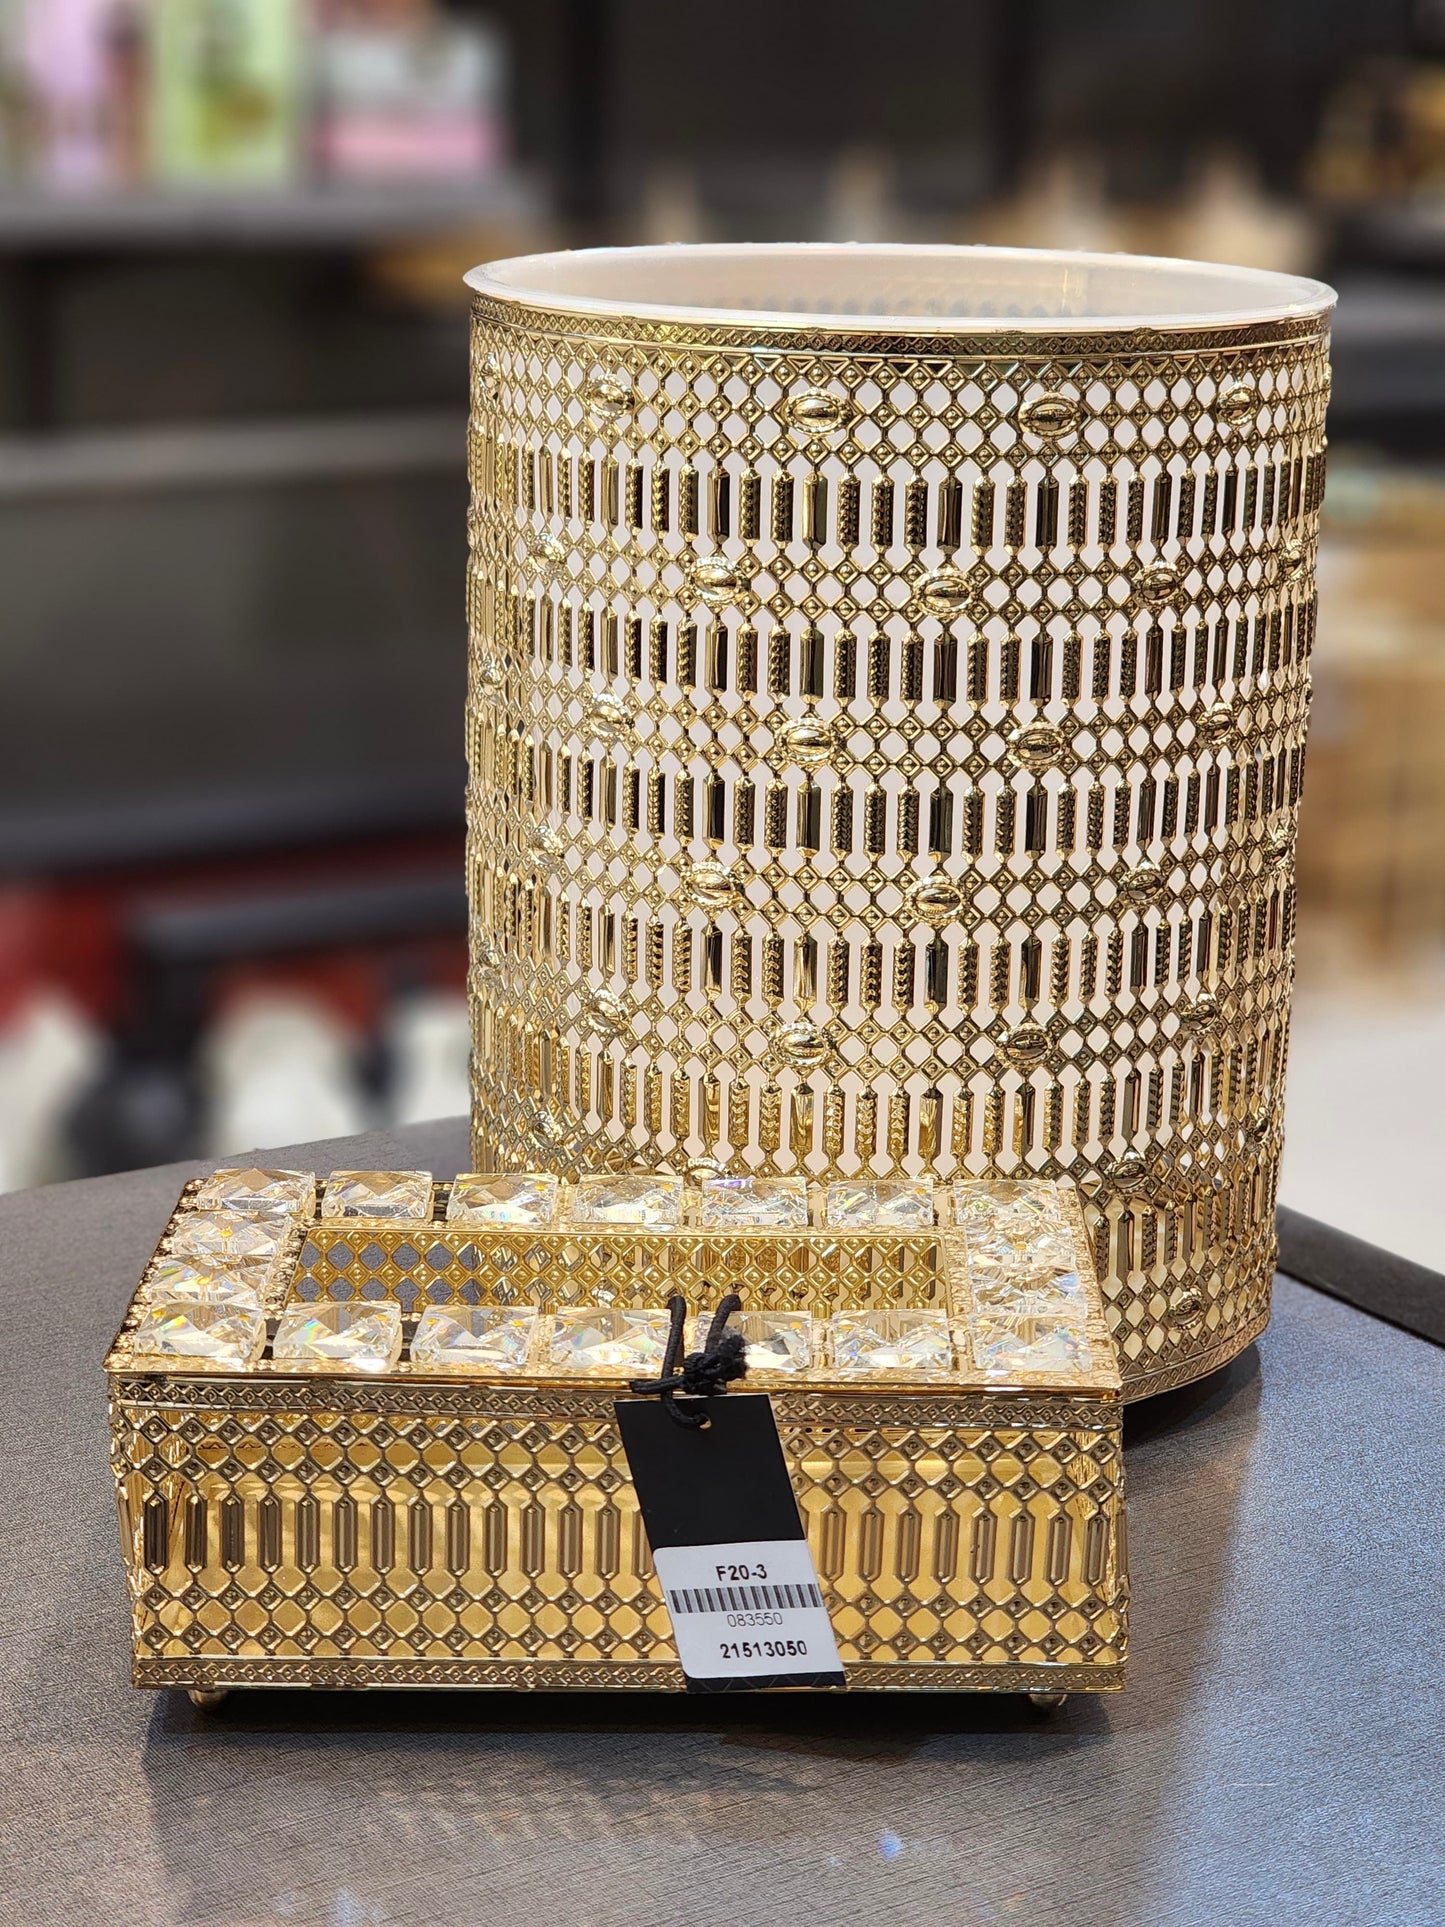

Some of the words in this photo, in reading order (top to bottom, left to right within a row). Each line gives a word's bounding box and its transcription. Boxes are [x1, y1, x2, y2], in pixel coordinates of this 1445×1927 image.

[716, 1564, 767, 1581] F20-3
[727, 1612, 783, 1627] 083550
[720, 1640, 807, 1658] 21513050
